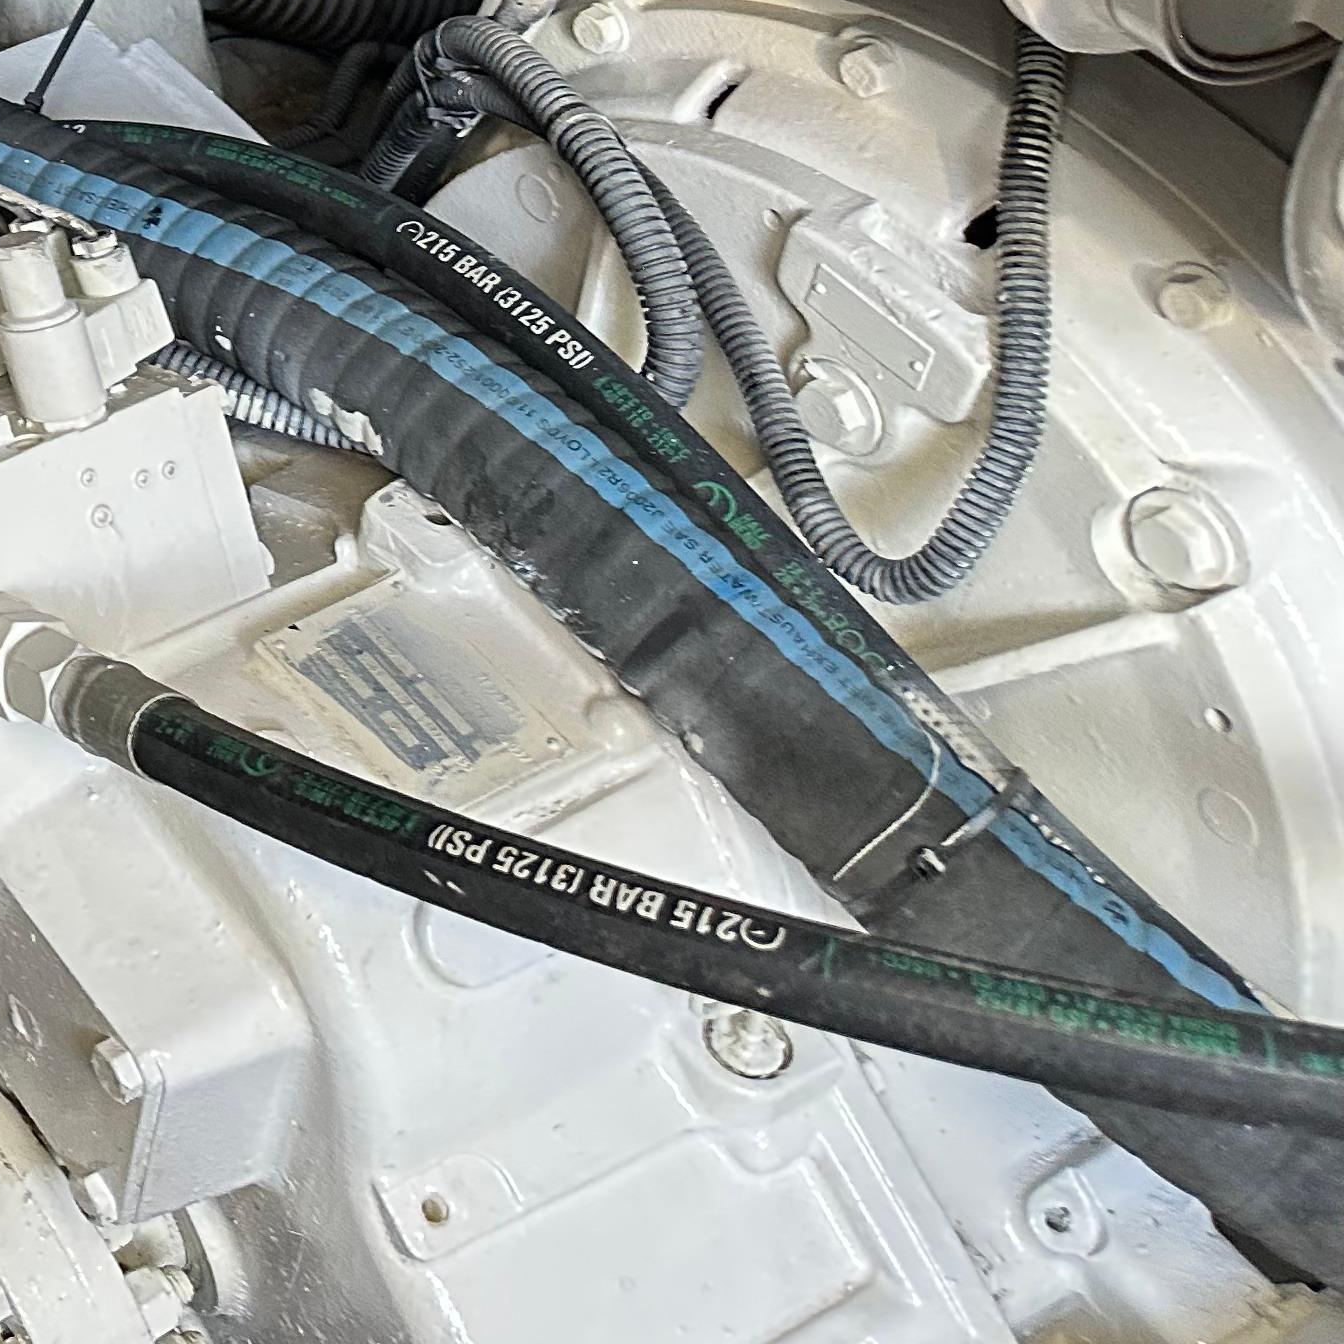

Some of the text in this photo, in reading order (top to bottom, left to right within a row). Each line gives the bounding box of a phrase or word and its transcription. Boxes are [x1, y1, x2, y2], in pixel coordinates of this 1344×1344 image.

[415, 230, 596, 370] 215 BAR (3125 PSI)
[661, 519, 701, 550] SAE
[427, 823, 741, 943] 215 BAR (3125 PSI)
